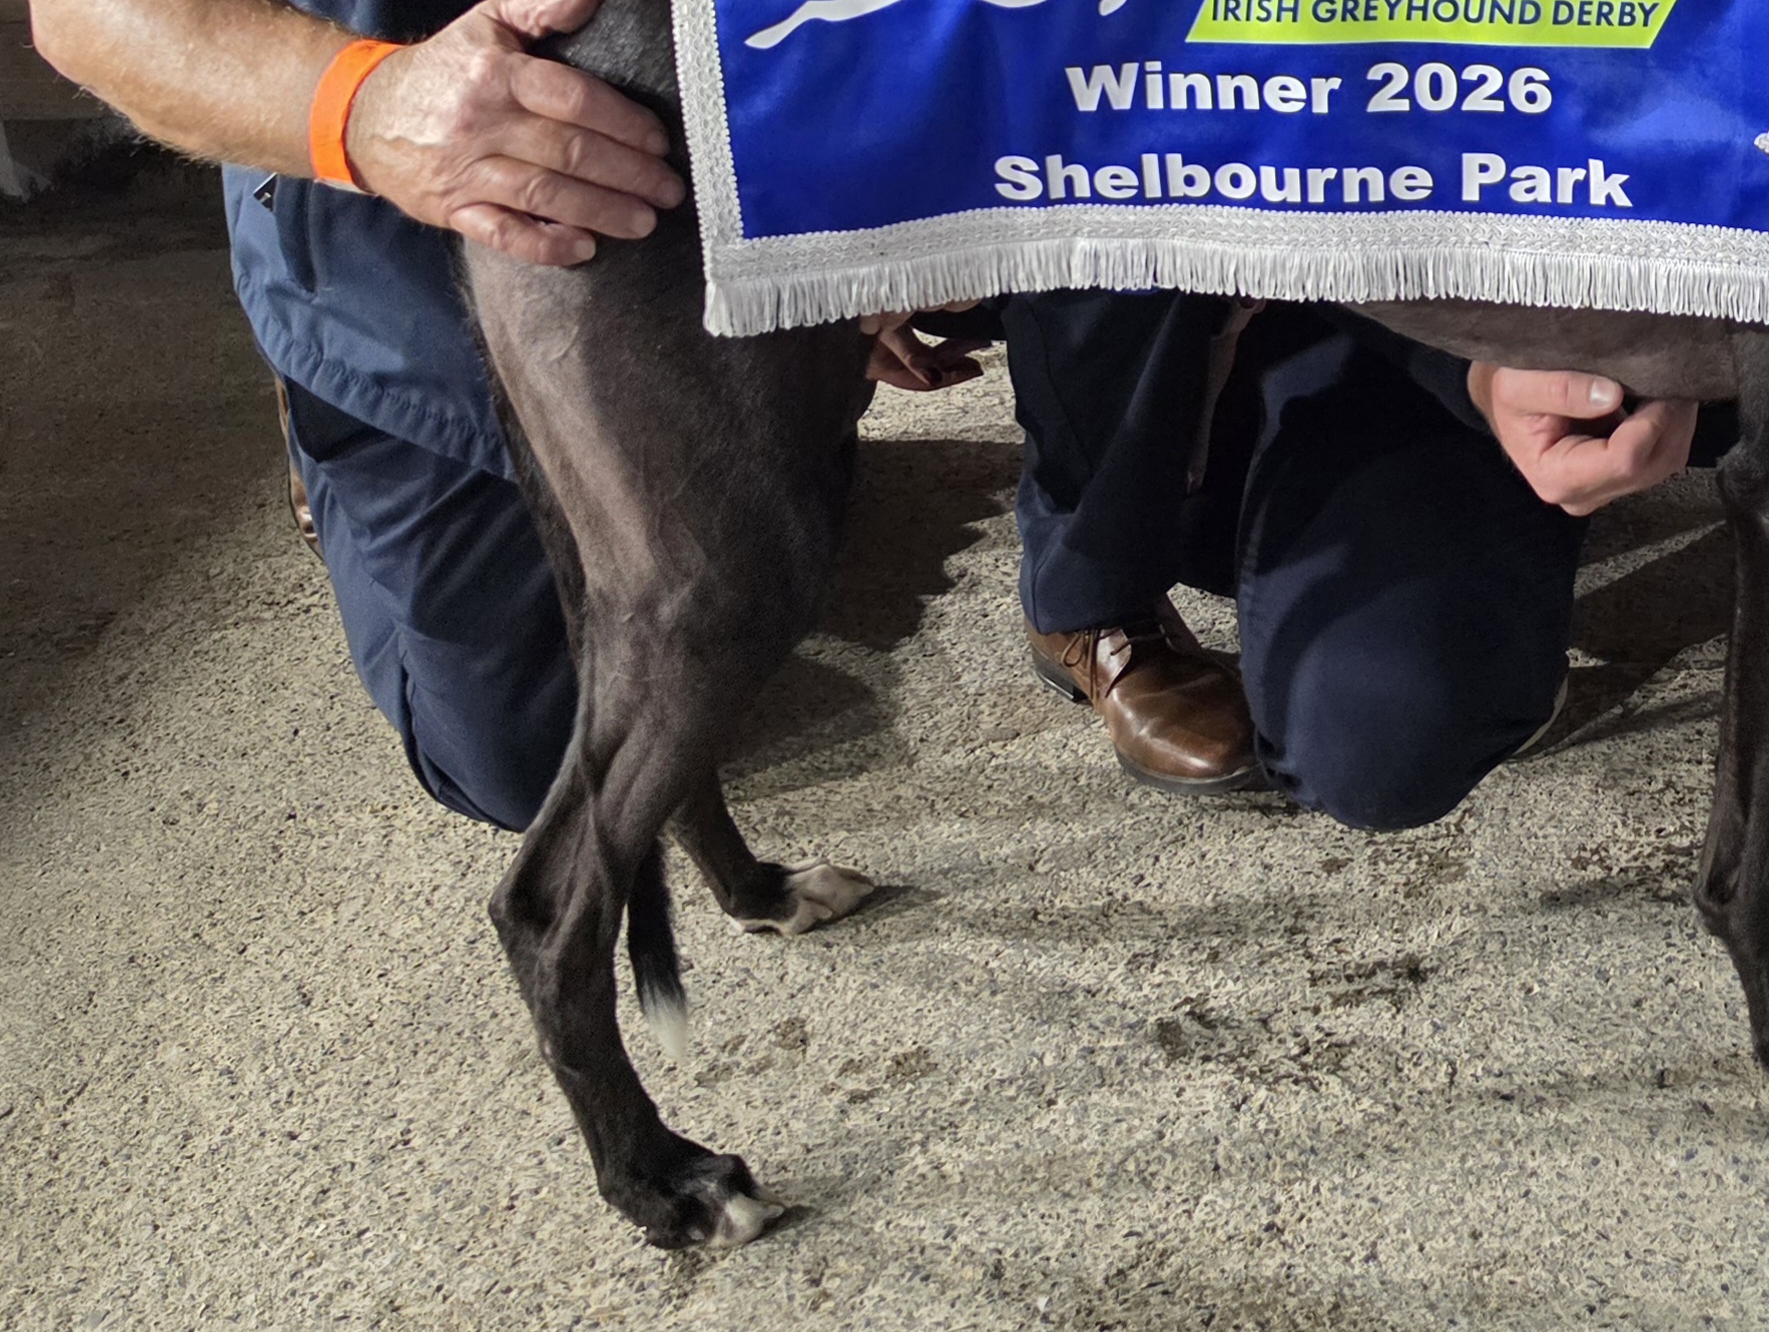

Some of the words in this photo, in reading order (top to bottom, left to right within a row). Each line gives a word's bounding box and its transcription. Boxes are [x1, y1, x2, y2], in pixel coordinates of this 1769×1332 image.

[1551, 0, 1660, 28] DERBY
[1064, 60, 1342, 114] Winner
[1366, 62, 1553, 114] 2026
[994, 153, 1433, 203] Shelbourne
[1461, 153, 1633, 208] Park
